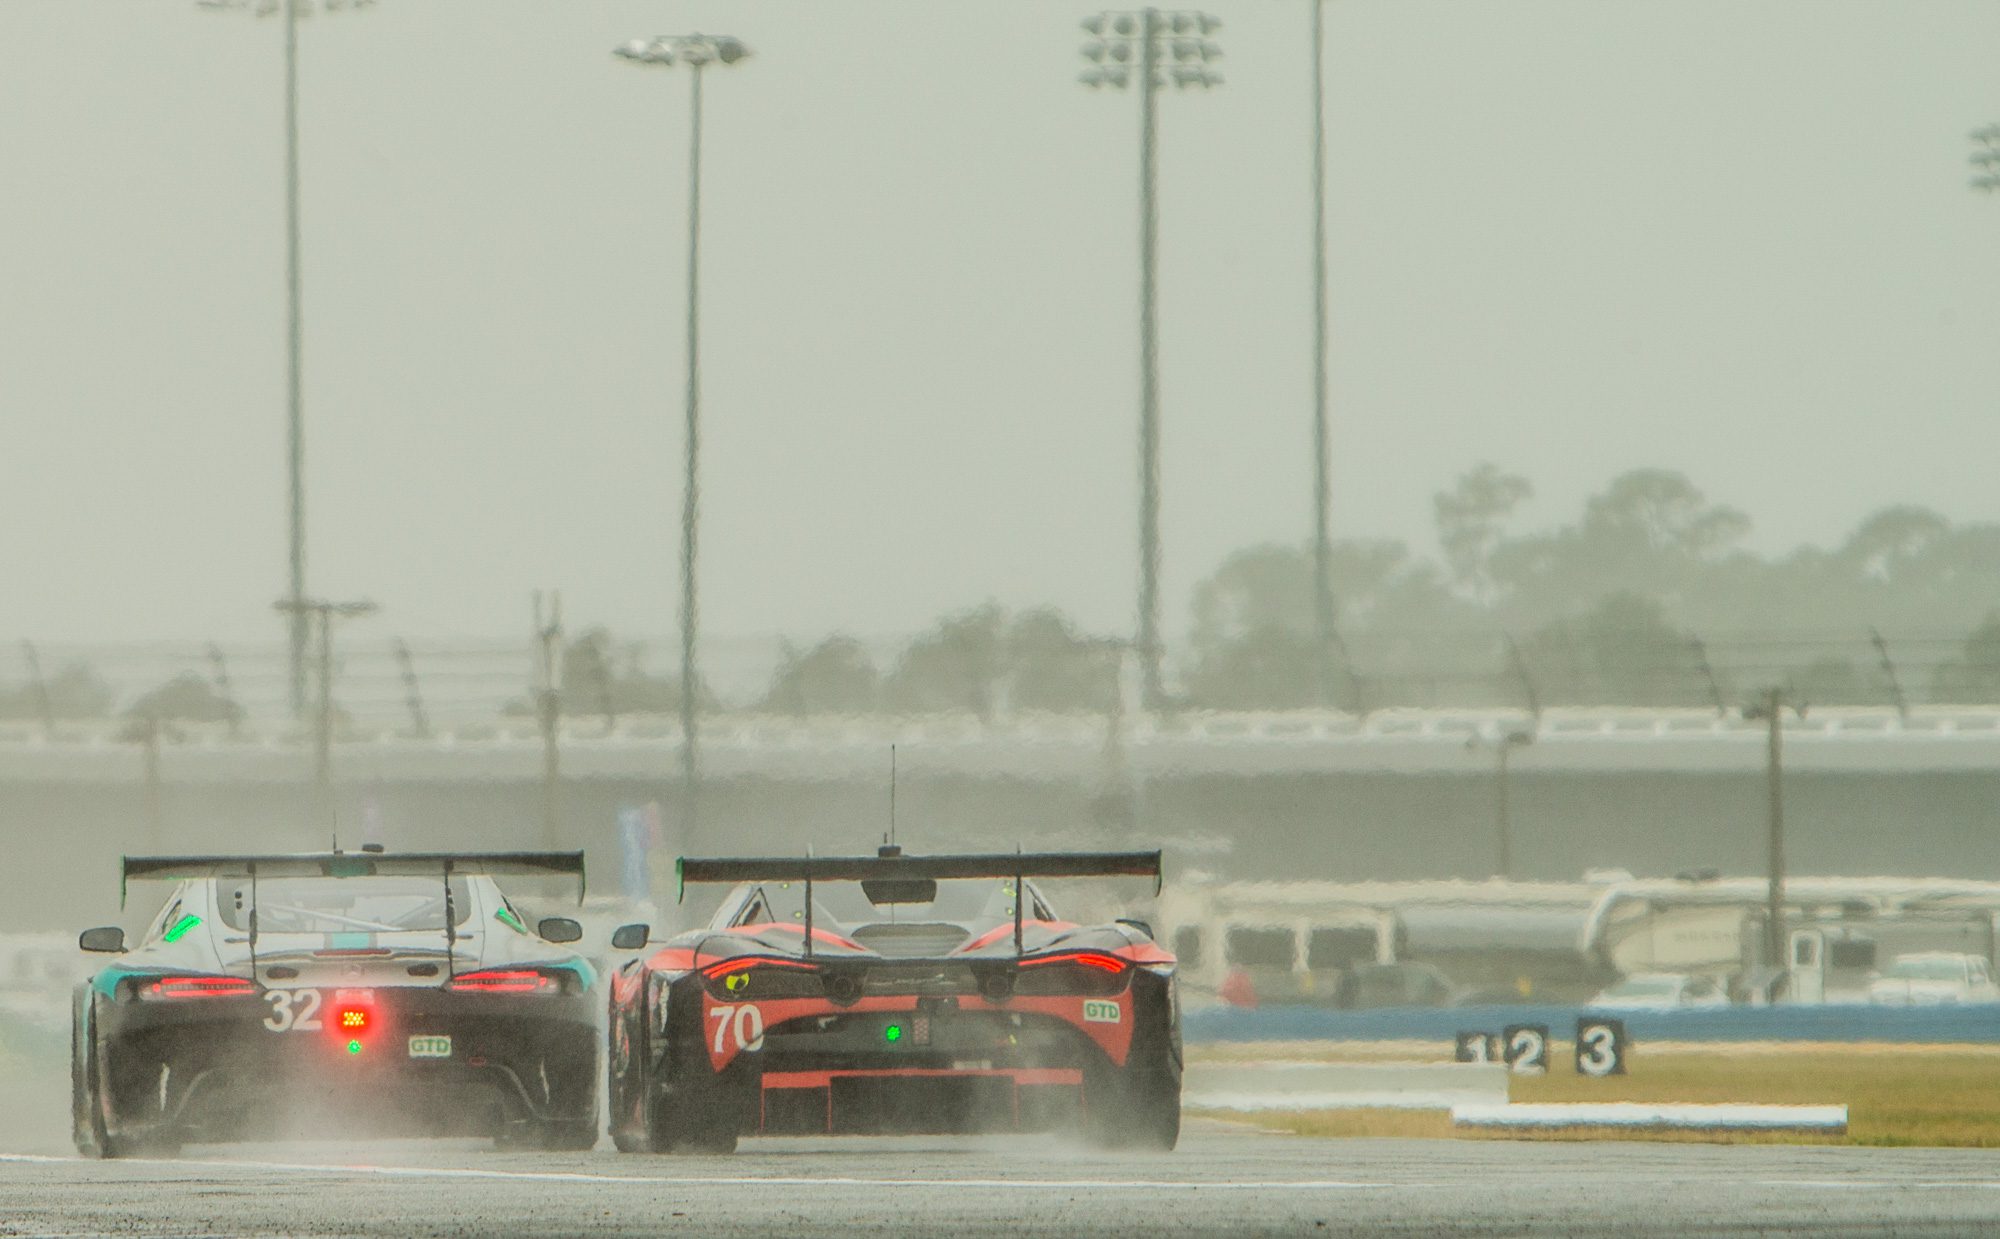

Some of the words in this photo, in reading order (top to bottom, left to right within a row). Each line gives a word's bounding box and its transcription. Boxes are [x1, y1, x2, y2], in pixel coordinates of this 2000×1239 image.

[263, 988, 322, 1032] 32
[710, 1004, 764, 1053] 70
[1086, 1003, 1119, 1019] GTD
[411, 1039, 449, 1053] GTD
[1466, 1034, 1488, 1063] 1
[1511, 1029, 1545, 1074] 2
[1580, 1025, 1616, 1076] 3
